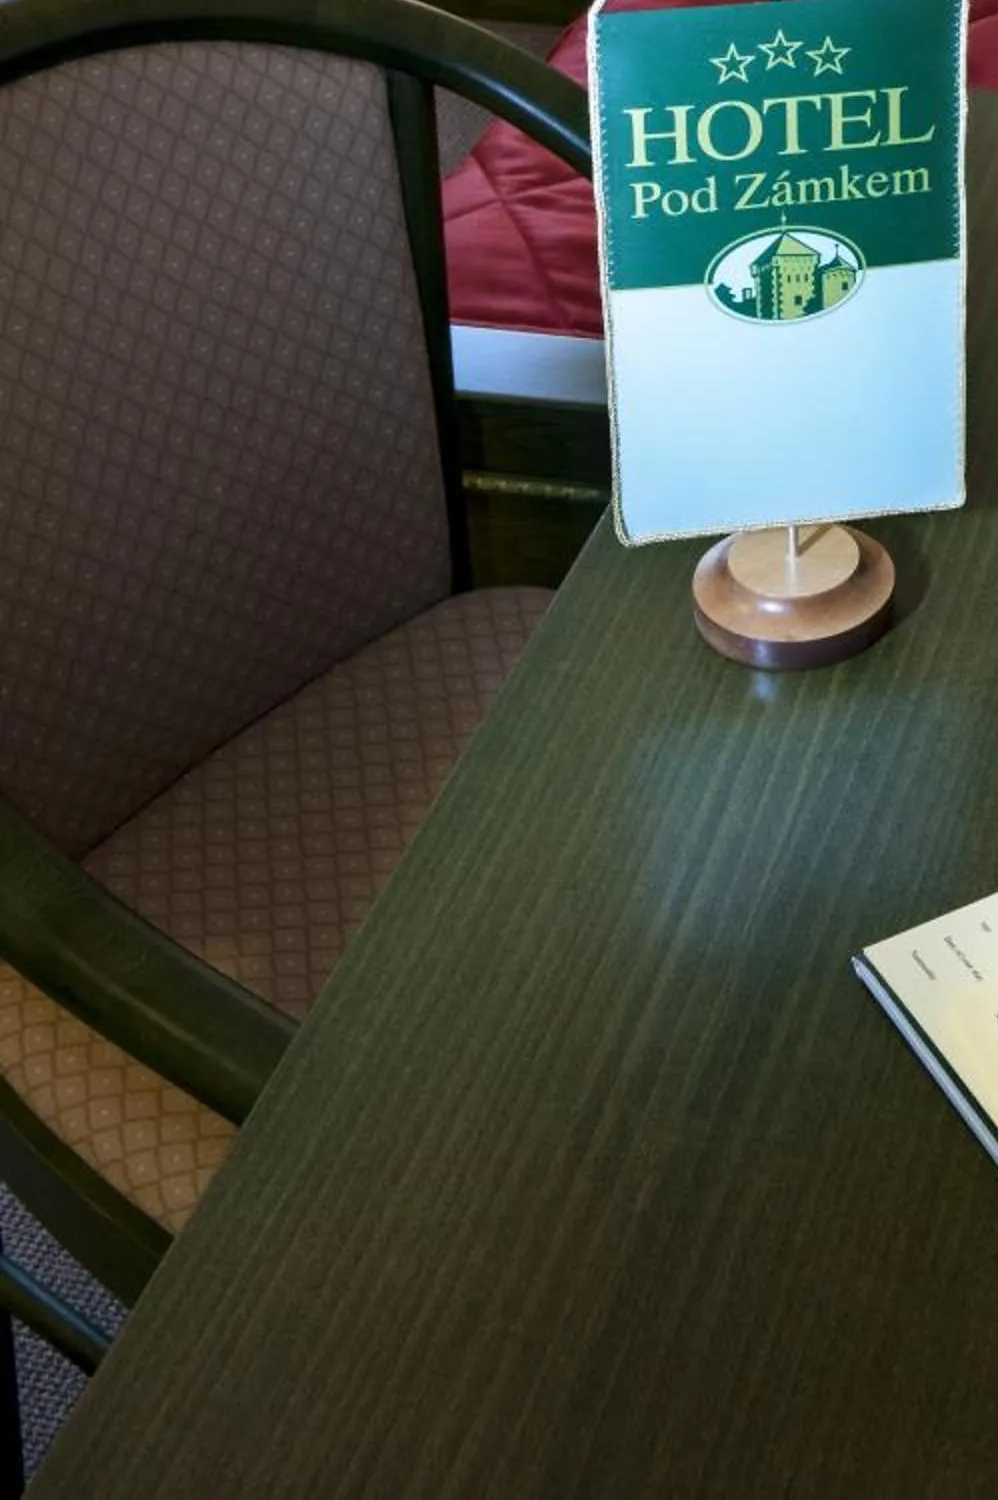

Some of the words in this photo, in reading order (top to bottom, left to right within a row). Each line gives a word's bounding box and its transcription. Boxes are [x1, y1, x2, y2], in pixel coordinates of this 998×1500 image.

[624, 86, 935, 168] HOTEL
[630, 177, 718, 218] Pod
[734, 164, 932, 211] Zámkem
